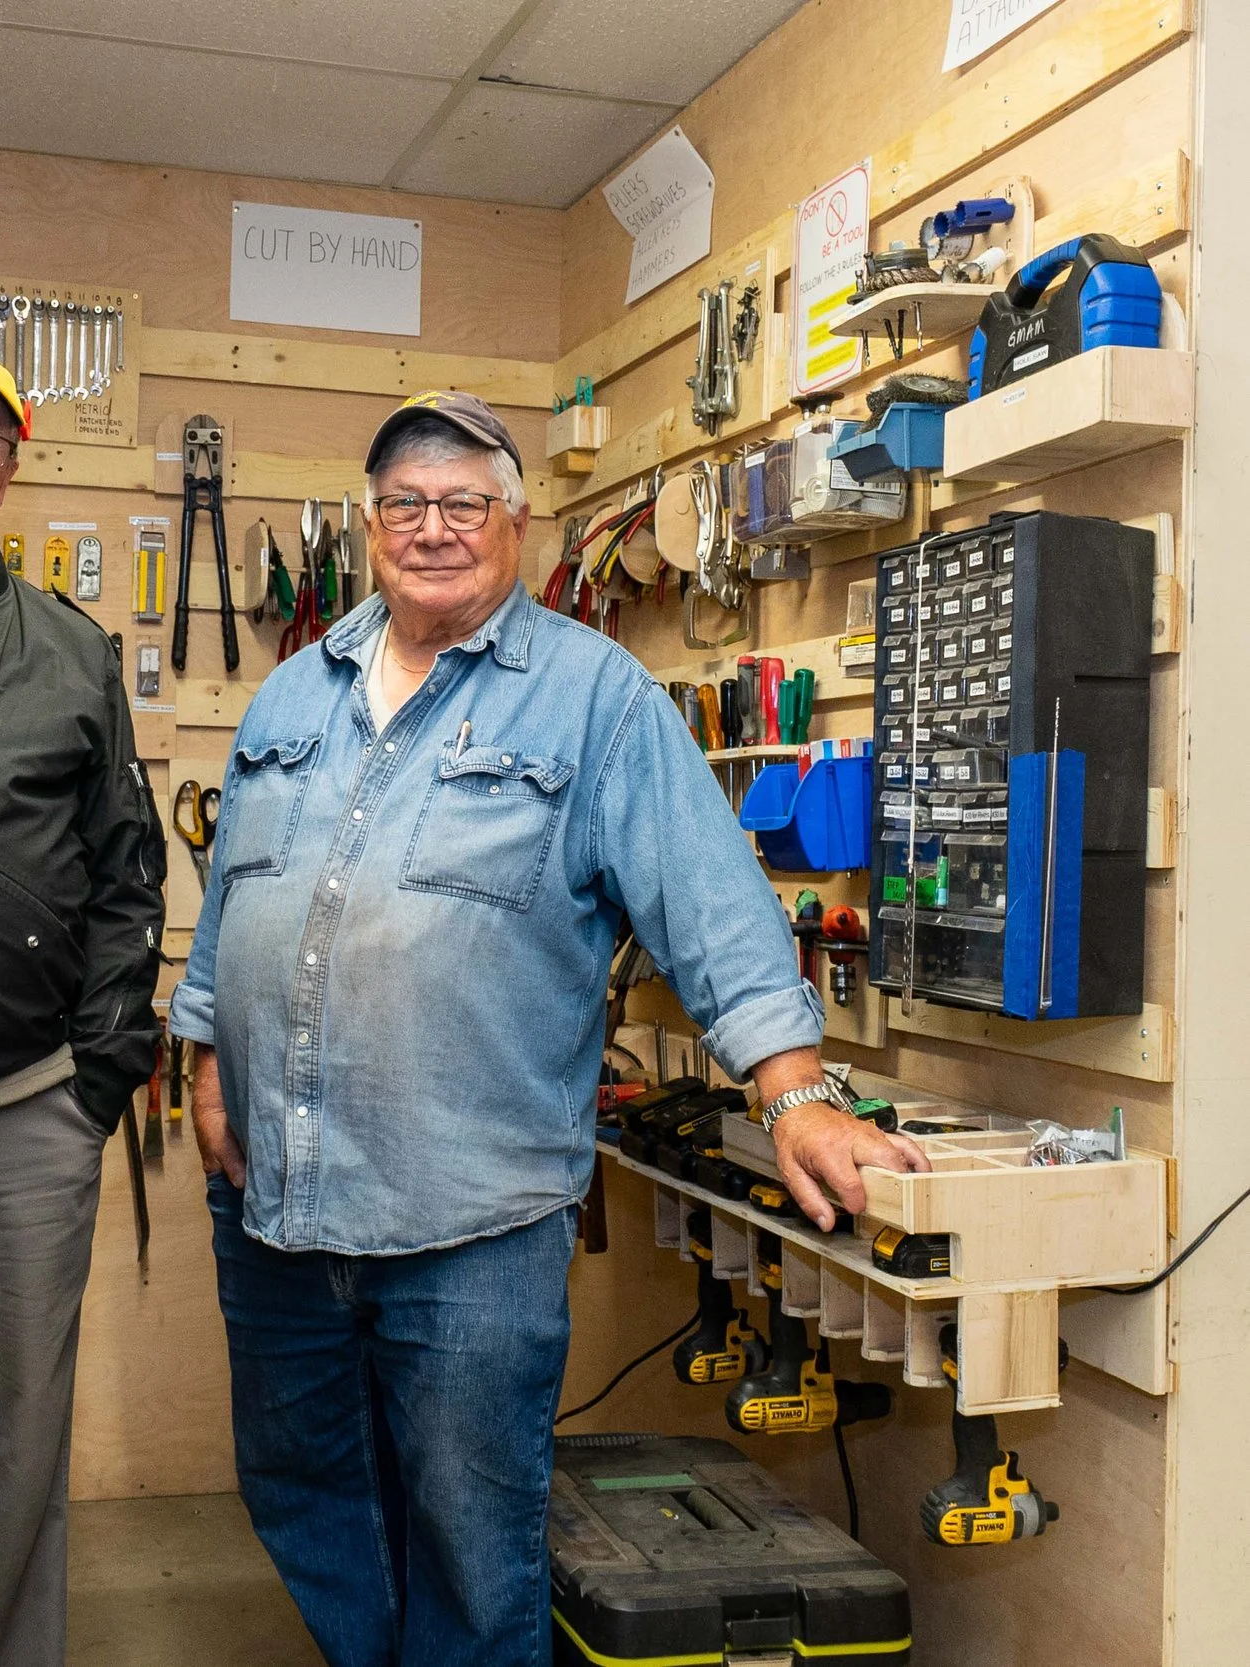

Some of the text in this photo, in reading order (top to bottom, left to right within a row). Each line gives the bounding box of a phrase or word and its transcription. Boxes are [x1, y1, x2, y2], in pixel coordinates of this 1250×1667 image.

[609, 172, 649, 214] PLIERS
[244, 226, 420, 271] CUT BY HAND
[822, 224, 864, 257] BE A TOOL
[800, 274, 823, 296] FOLLOW
[824, 265, 836, 281] THE
[842, 252, 863, 270] RULES
[14, 286, 24, 295] 15
[32, 287, 42, 296] 14
[48, 290, 57, 298] 13
[64, 291, 73, 300] 12
[78, 293, 86, 301] 11
[92, 294, 101, 302] 10
[1014, 350, 1047, 366] HOLE SAW
[75, 403, 110, 416] METRIC
[79, 417, 106, 426] RATCHET
[109, 419, 123, 427] END
[78, 426, 104, 435] OPENED
[105, 428, 120, 436] END
[975, 1523, 1005, 1532] DEWALT
